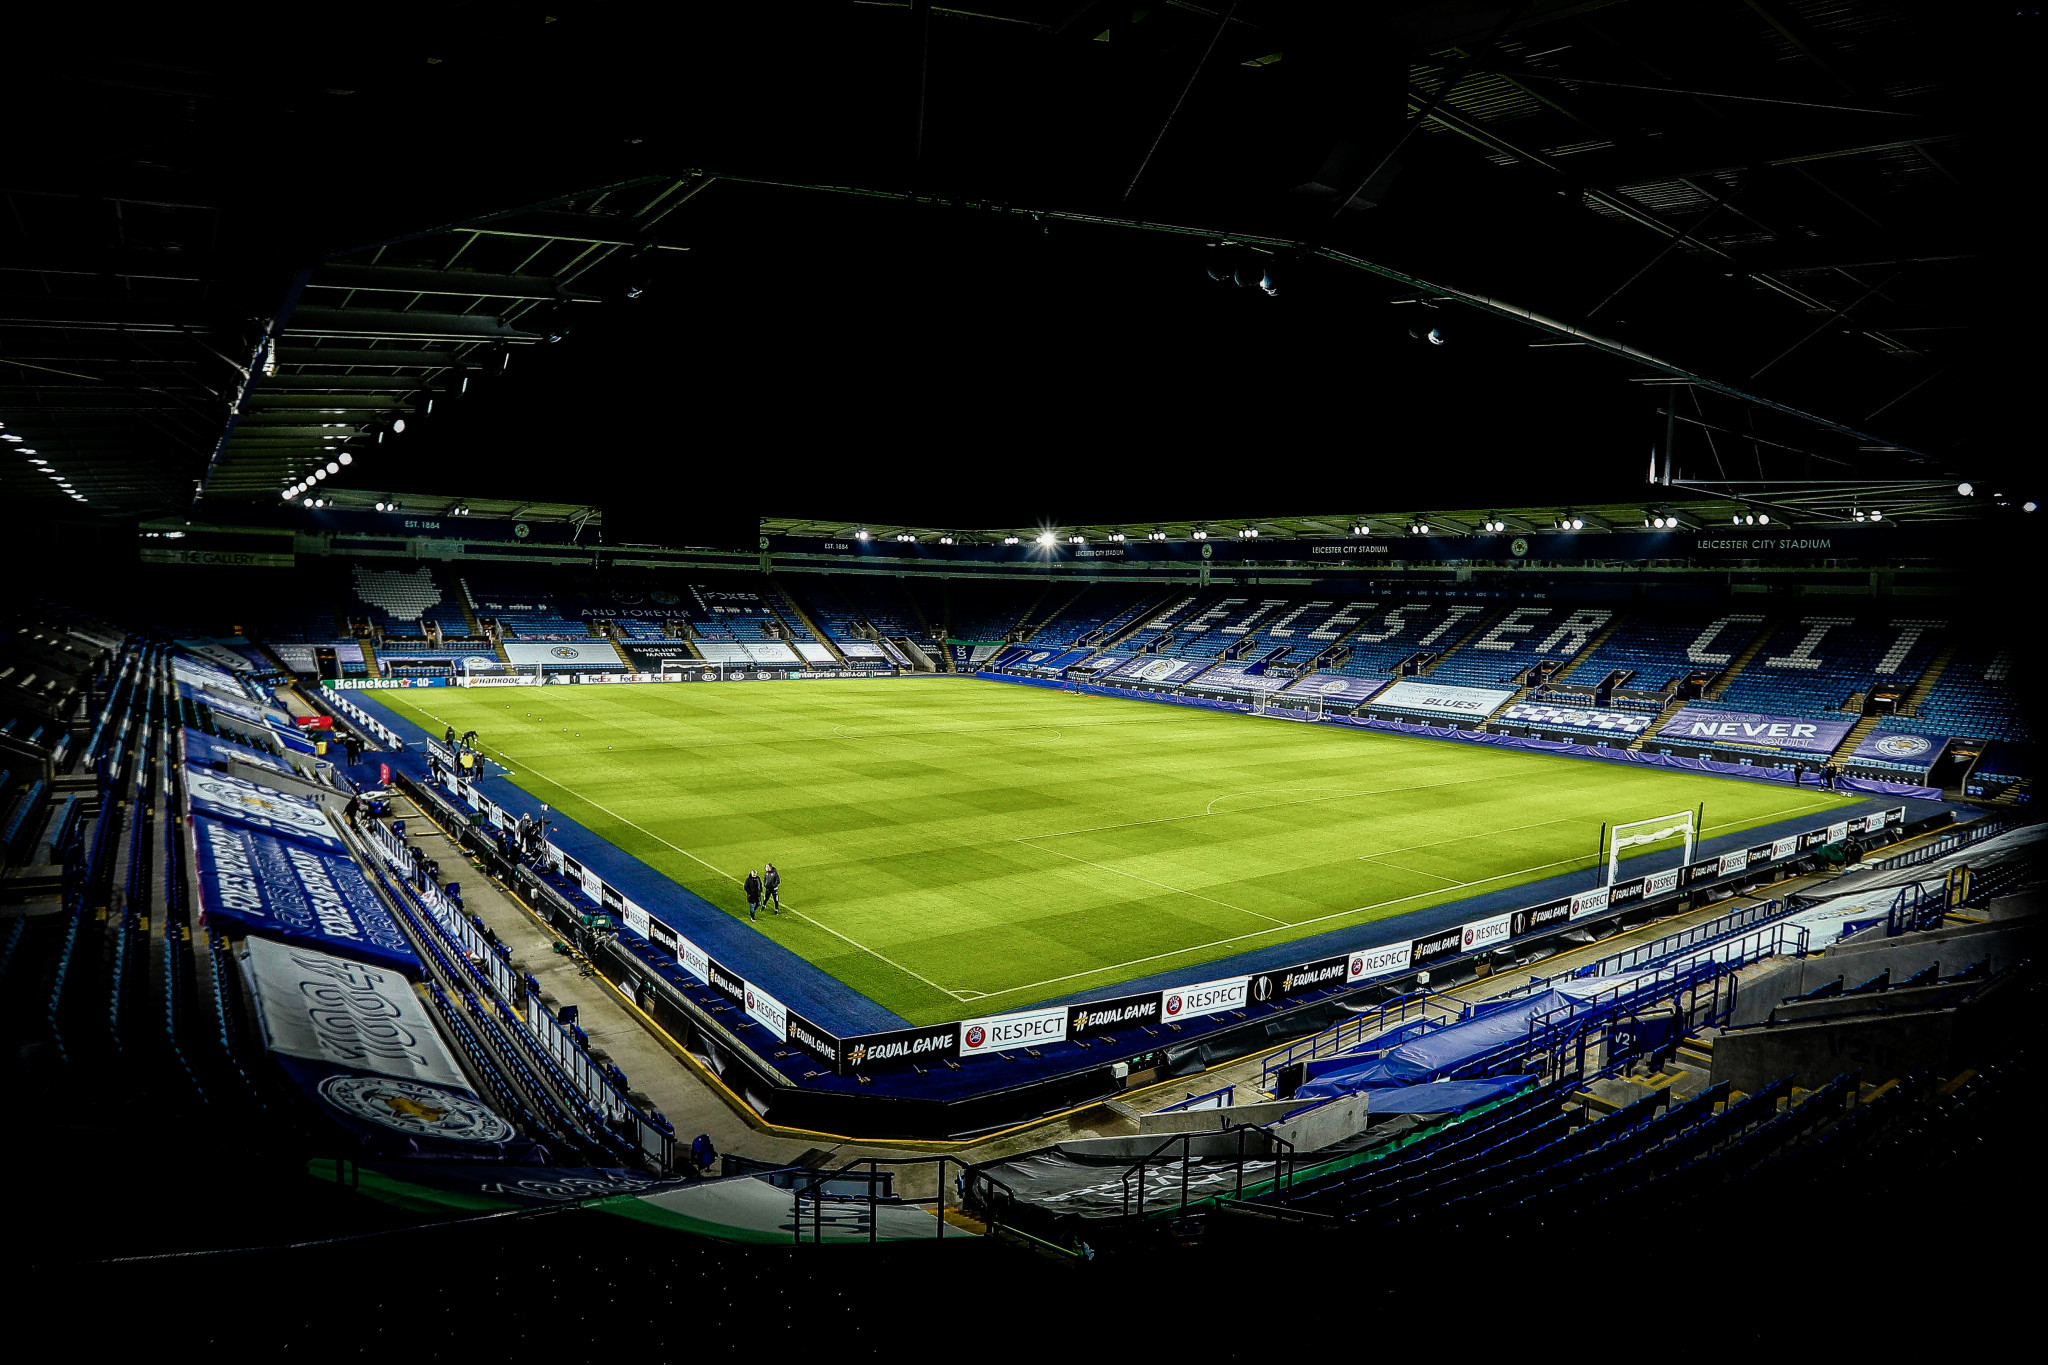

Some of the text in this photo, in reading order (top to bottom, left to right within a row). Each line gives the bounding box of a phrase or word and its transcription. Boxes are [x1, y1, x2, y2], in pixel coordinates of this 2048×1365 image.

[405, 520, 440, 529] EST. 1884
[1312, 544, 1388, 554] LEICESTER CITY STADIUM
[1697, 538, 1832, 550] LEICESTER CITY STADIUM
[180, 551, 255, 563] THE GALLERY
[622, 609, 691, 617] FOREVER
[1146, 597, 1612, 655] LEICESTER
[334, 679, 398, 689] Heineken
[588, 674, 611, 683] FedEx
[620, 674, 643, 682] FedEx
[1422, 697, 1483, 710] BLUES!
[1691, 722, 1817, 738] NEVER
[1628, 884, 1643, 899] GAME
[1653, 875, 1678, 891] RESPECT
[217, 873, 265, 917] FOXES
[1581, 893, 1608, 912] RESPECT
[311, 897, 365, 942] FOXES
[630, 910, 649, 932] RESPECT
[1531, 904, 1569, 927] #EQUAL GAME
[649, 923, 678, 952] #EQUAL GAME
[1476, 921, 1509, 940] RESPECT
[1413, 935, 1460, 960] #EQUAL GAME
[686, 948, 708, 975] RESPECT
[1366, 949, 1409, 971] RESPECT
[709, 967, 743, 1001] #EQUAL GAME
[1283, 964, 1344, 992] #EQUAL GAME
[1186, 984, 1247, 1010] RESPECT
[756, 1001, 786, 1031] RESPECT
[1072, 1002, 1157, 1033] #EQUAL GAME
[789, 1021, 836, 1061] #EQUAL GAME
[991, 1017, 1062, 1043] RESPECT
[848, 1033, 953, 1066] #EQUAL GAME
